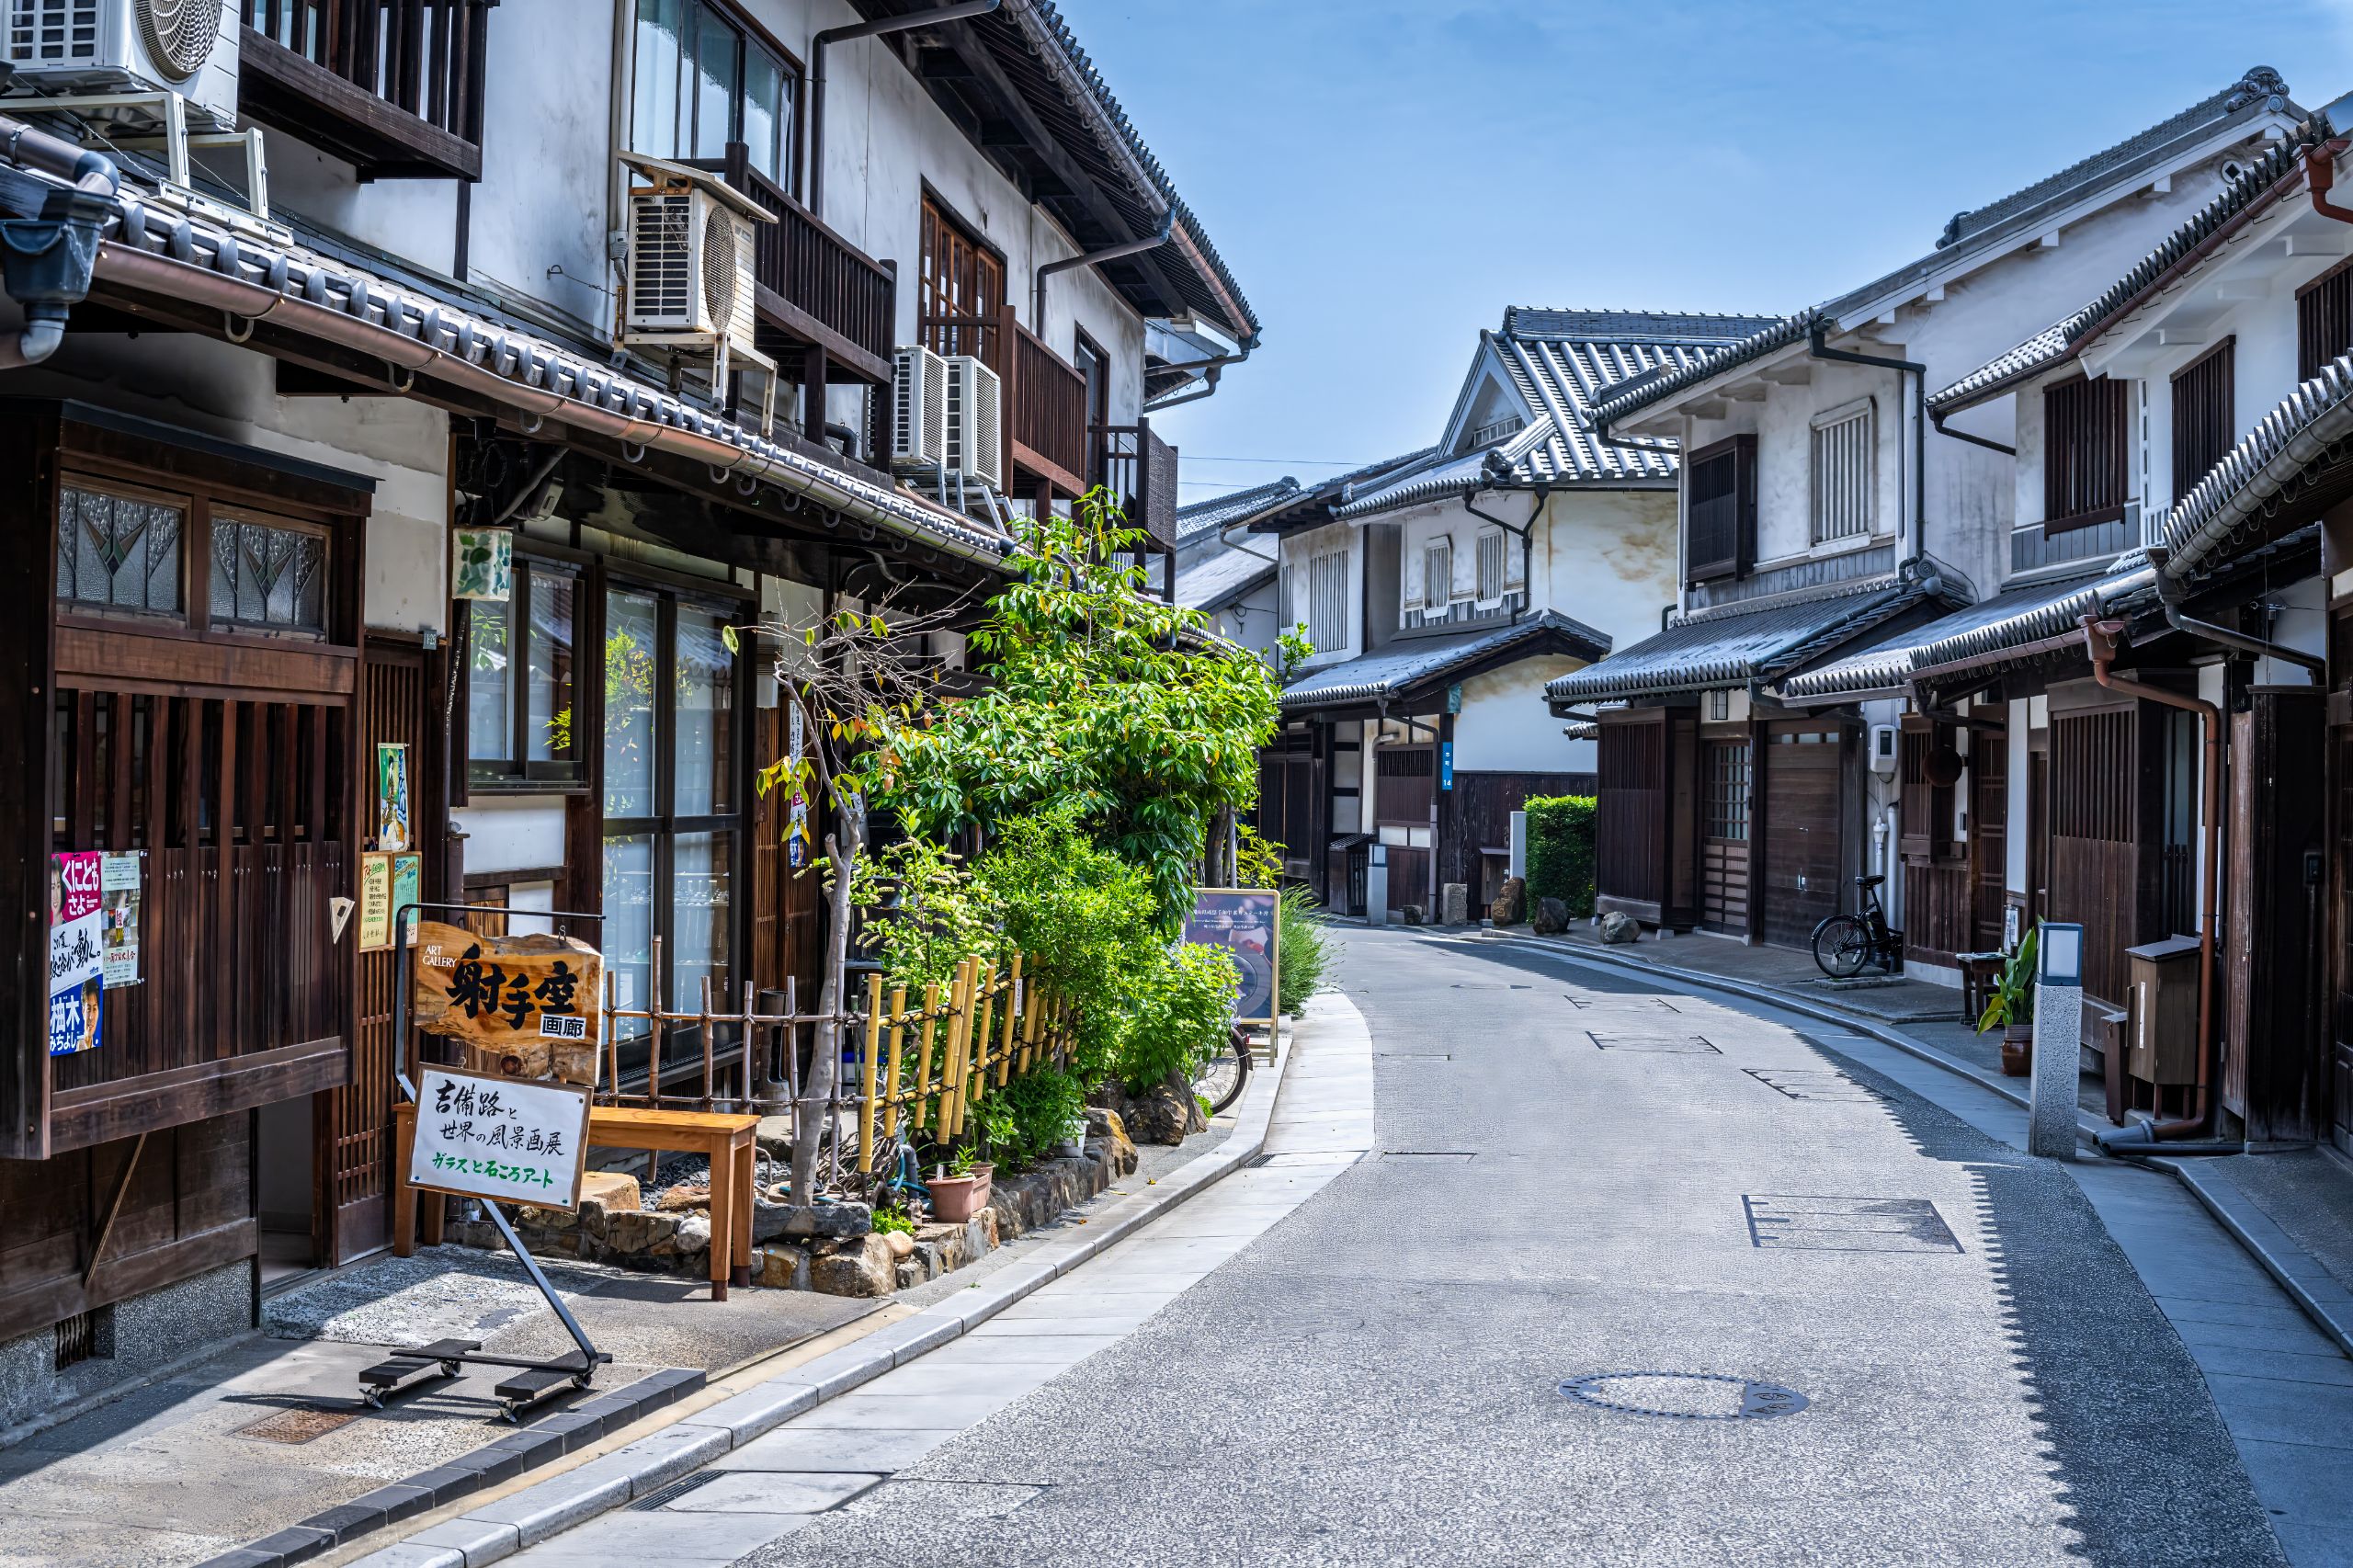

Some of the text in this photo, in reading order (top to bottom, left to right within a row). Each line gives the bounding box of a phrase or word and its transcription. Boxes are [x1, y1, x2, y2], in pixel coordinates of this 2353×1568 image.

[62, 858, 99, 892] くにとも
[68, 894, 86, 915] さよ
[423, 956, 457, 968] GALLERY
[425, 945, 443, 956] ART
[51, 994, 81, 1034] 柚木
[542, 1016, 585, 1038] 画廊
[50, 1031, 77, 1051] みちよし
[435, 1079, 517, 1119] 吉備路と
[439, 1119, 565, 1156] 世界の風景画展
[431, 1151, 553, 1188] ガラスと石ころアート
